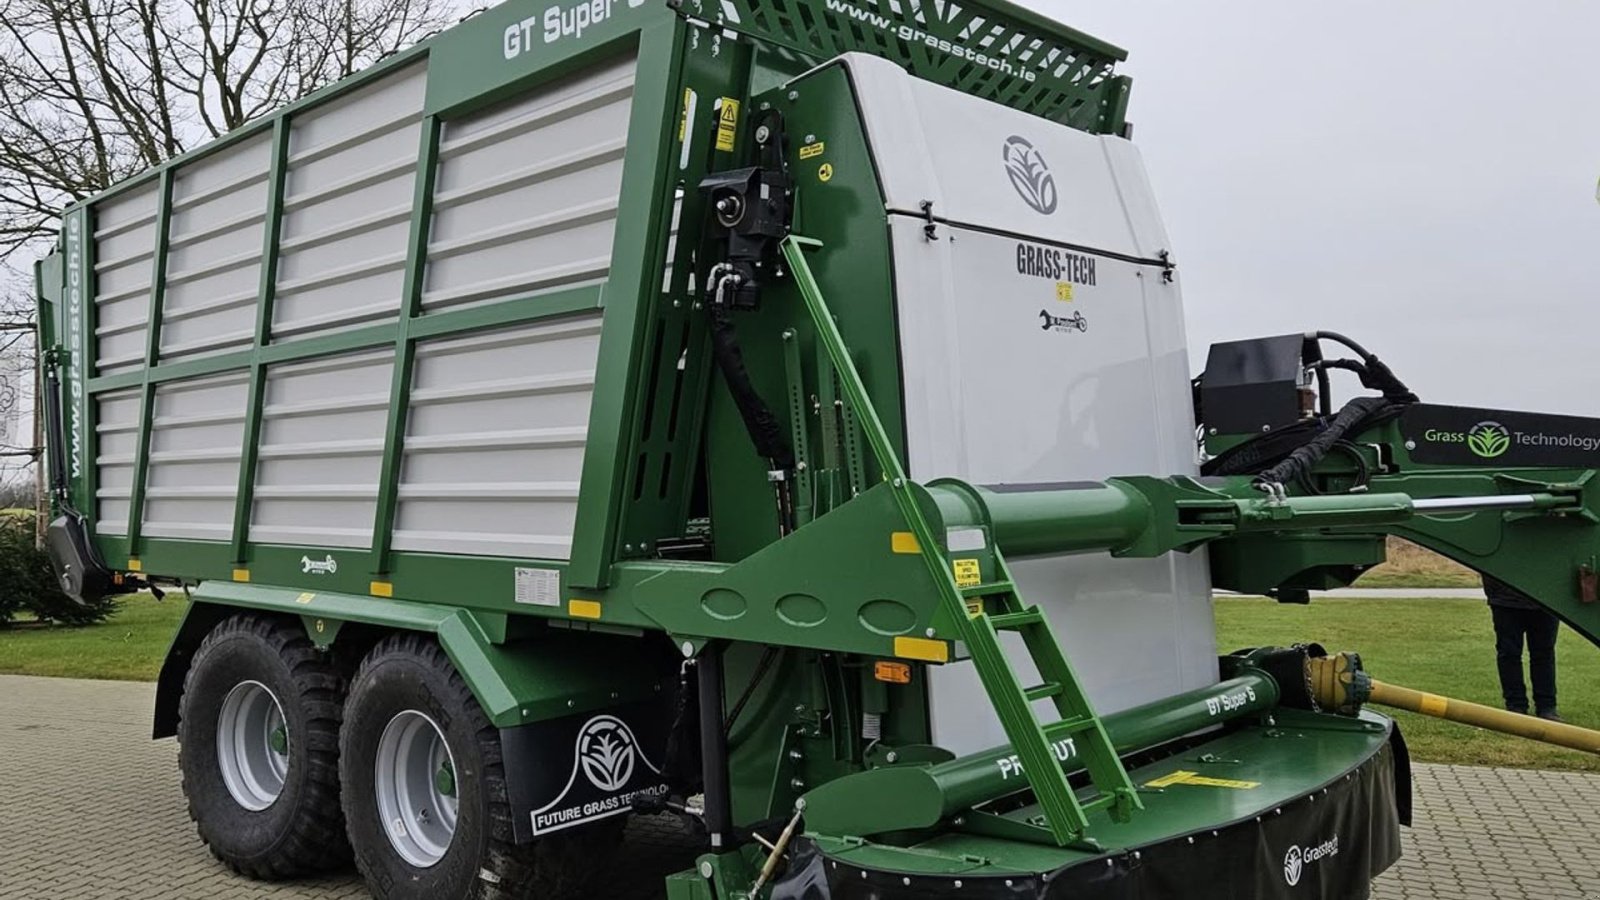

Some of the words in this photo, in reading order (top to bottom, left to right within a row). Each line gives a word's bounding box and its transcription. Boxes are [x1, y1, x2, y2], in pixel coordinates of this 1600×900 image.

[504, 16, 536, 60] GT
[825, 0, 1036, 82] www.grasstech.ie
[1016, 243, 1096, 286] GRASS-TECH
[69, 216, 82, 479] www.grasstech.ie
[1425, 429, 1465, 442] Grass
[1514, 431, 1600, 450] Technology
[1206, 698, 1221, 716] GT
[1220, 694, 1247, 711] Super
[1246, 686, 1256, 702] 6
[537, 806, 582, 828] FUTURE
[583, 796, 619, 815] GRASS
